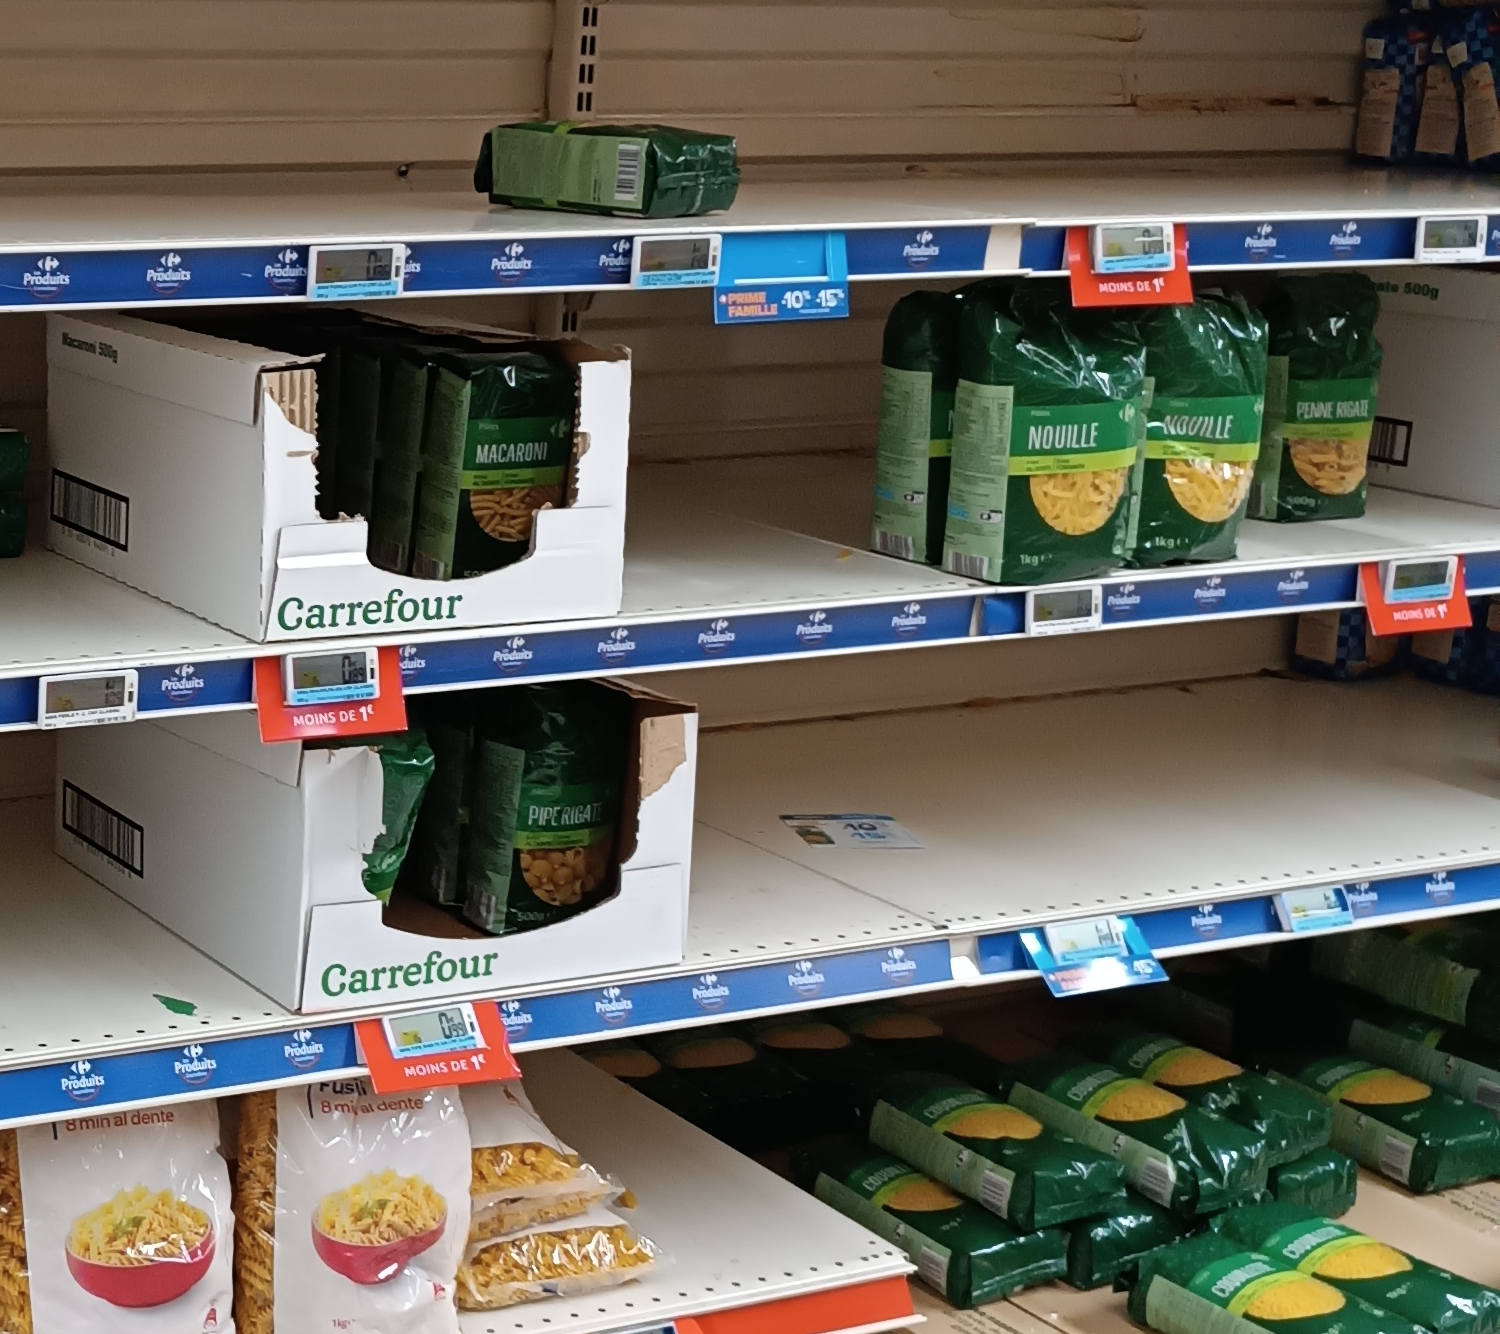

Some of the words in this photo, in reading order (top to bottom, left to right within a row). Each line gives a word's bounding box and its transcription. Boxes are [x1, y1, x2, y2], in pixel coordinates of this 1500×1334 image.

[23, 271, 72, 288] Produits
[146, 267, 191, 284] Produits
[264, 262, 308, 280] Produits
[1098, 279, 1134, 295] MOINS
[1137, 279, 1151, 293] DE
[1402, 280, 1440, 301] 500g
[728, 291, 767, 306] PRIME
[728, 304, 779, 318] FAMILLE
[61, 330, 96, 358] Macaroni
[98, 343, 119, 365] 500g
[1296, 400, 1331, 421] PENNE
[1162, 415, 1234, 440] NOUILLE
[1027, 422, 1099, 451] NOUILLE
[475, 442, 549, 466] MACARONI
[277, 589, 463, 633] Carrefour
[1393, 610, 1420, 623] MOINS
[1423, 609, 1436, 621] DE
[698, 630, 735, 644] Produits
[796, 621, 833, 637] Produits
[492, 647, 533, 662] Produits
[162, 676, 204, 692] Produits
[293, 711, 336, 729] MOINS
[339, 708, 357, 724] DE
[527, 805, 559, 826] PIPE
[321, 949, 499, 998] Carrefour
[788, 970, 825, 987] Produits
[692, 983, 729, 1001] Produits
[284, 1040, 325, 1056] Produits
[174, 1057, 217, 1074] Produits
[404, 1061, 447, 1079] MOINS
[450, 1059, 468, 1074] DE
[320, 1100, 332, 1114] 8
[377, 1097, 424, 1112] dente
[66, 1117, 76, 1132] 8
[79, 1116, 110, 1131] min
[114, 1113, 127, 1127] al
[130, 1107, 175, 1126] dente
